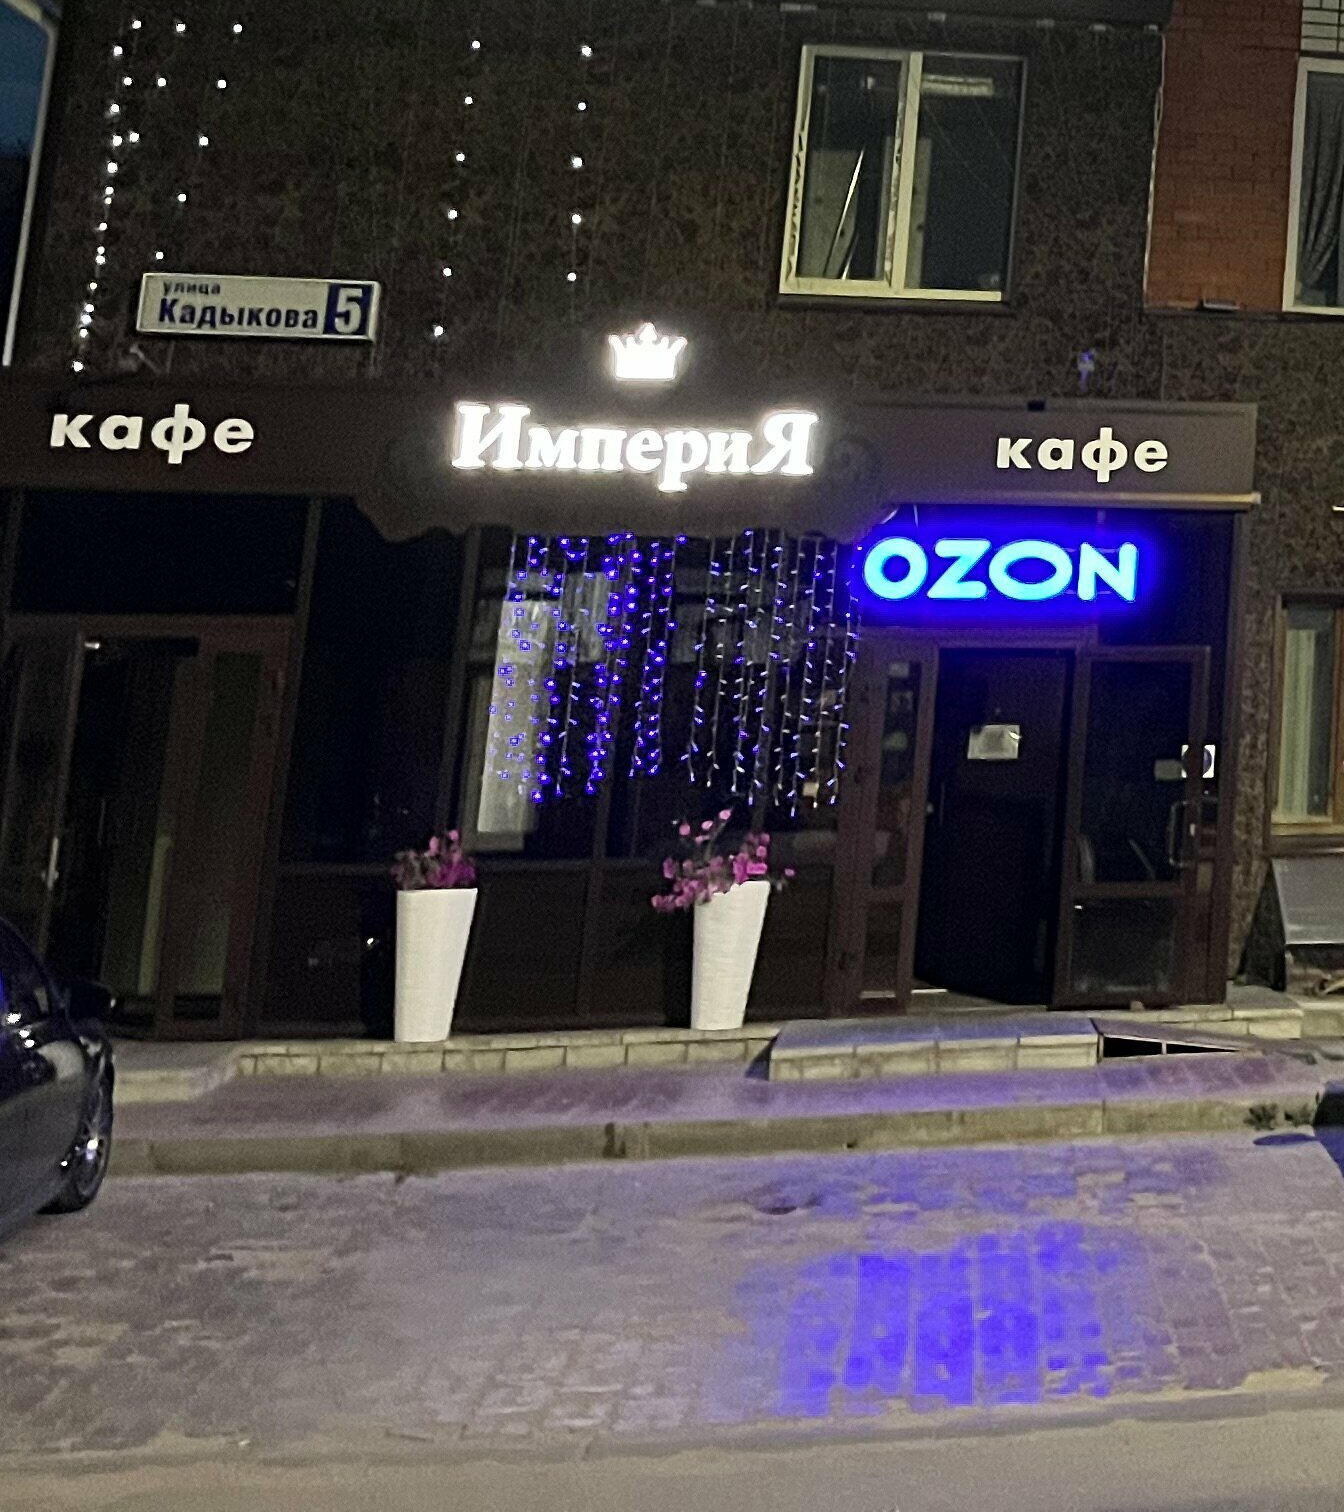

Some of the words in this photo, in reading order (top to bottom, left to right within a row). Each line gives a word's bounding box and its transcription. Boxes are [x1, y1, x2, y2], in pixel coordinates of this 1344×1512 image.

[158, 298, 319, 329] Кадыкова
[334, 287, 363, 334] 5
[163, 282, 221, 295] улица
[50, 403, 255, 465] кафе
[996, 426, 1169, 483] кафе
[863, 537, 1137, 602] OZON
